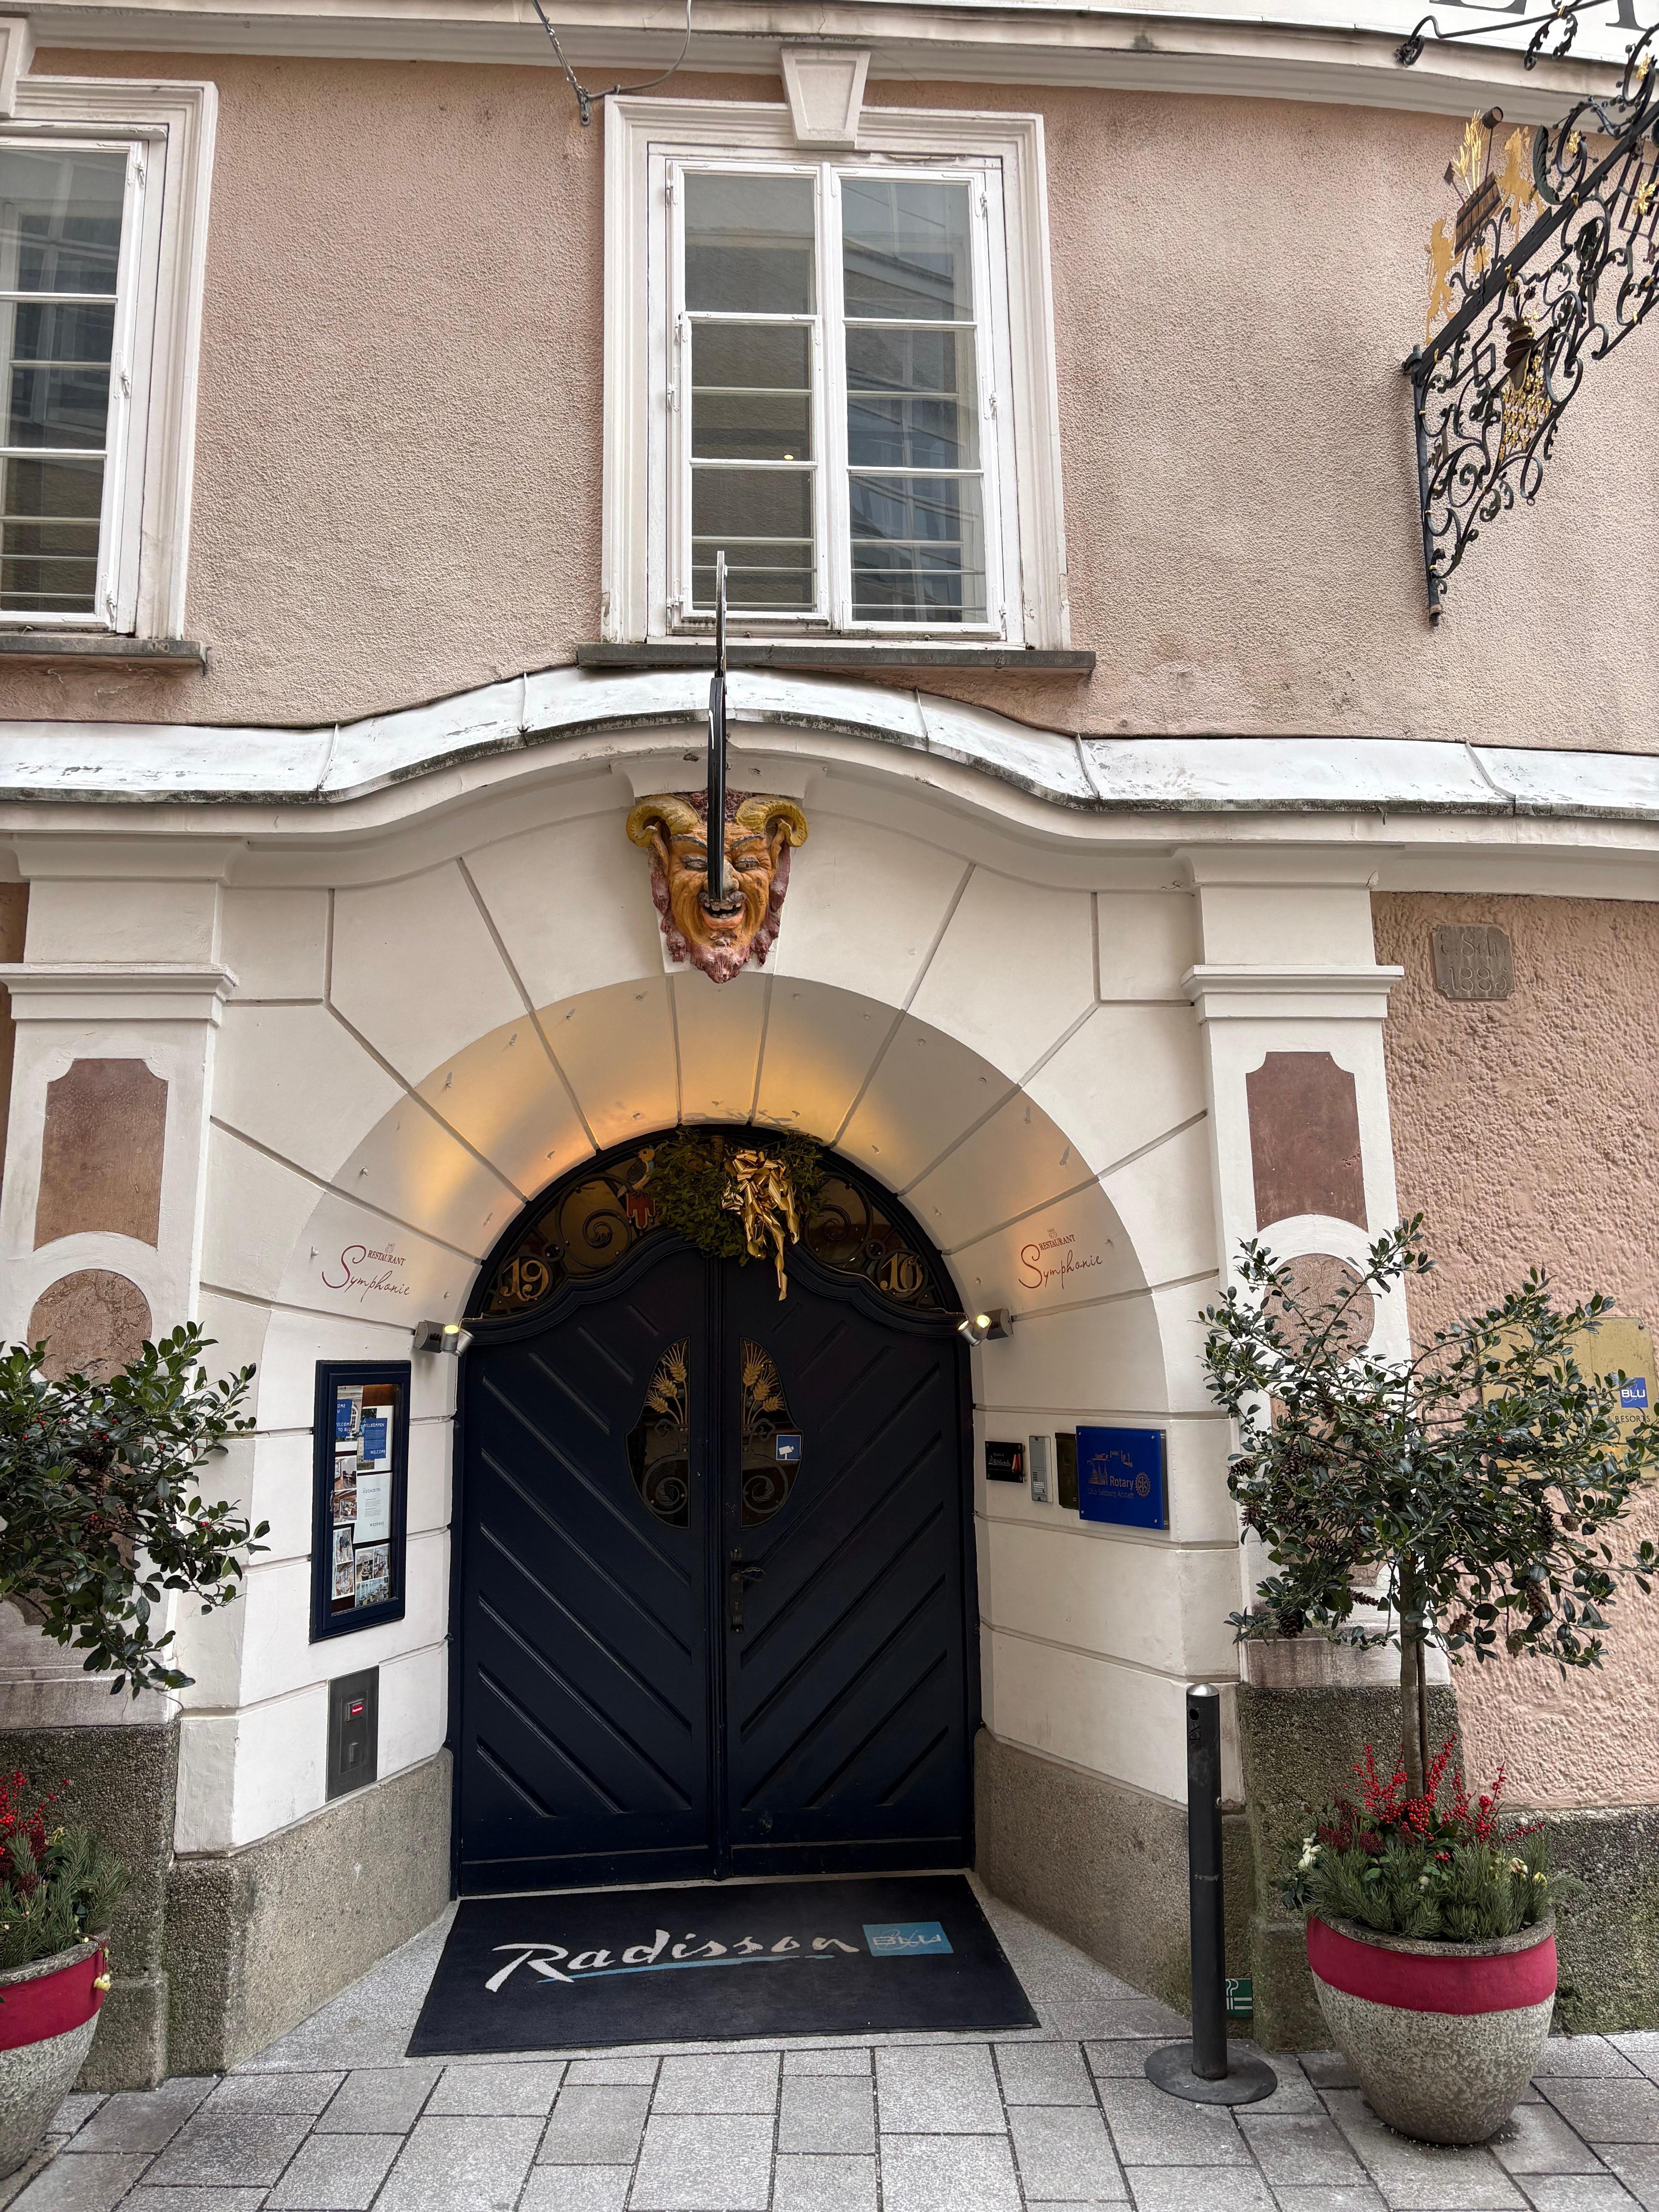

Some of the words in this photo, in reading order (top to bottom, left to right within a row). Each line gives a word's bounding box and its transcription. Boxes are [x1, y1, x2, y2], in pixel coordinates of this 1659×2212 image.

[1039, 1234, 1075, 1250] RESTAURANT
[368, 1250, 406, 1266] RESTAURANT
[880, 1252, 922, 1292] 10
[1018, 1244, 1103, 1289] Symphonie
[321, 1245, 410, 1303] Symphonie
[500, 1257, 549, 1302] 19
[1621, 1389, 1645, 1398] BLU
[1615, 1415, 1650, 1424] RESORTS
[1110, 1476, 1133, 1490] Rotary
[485, 1929, 859, 1993] Radisson
